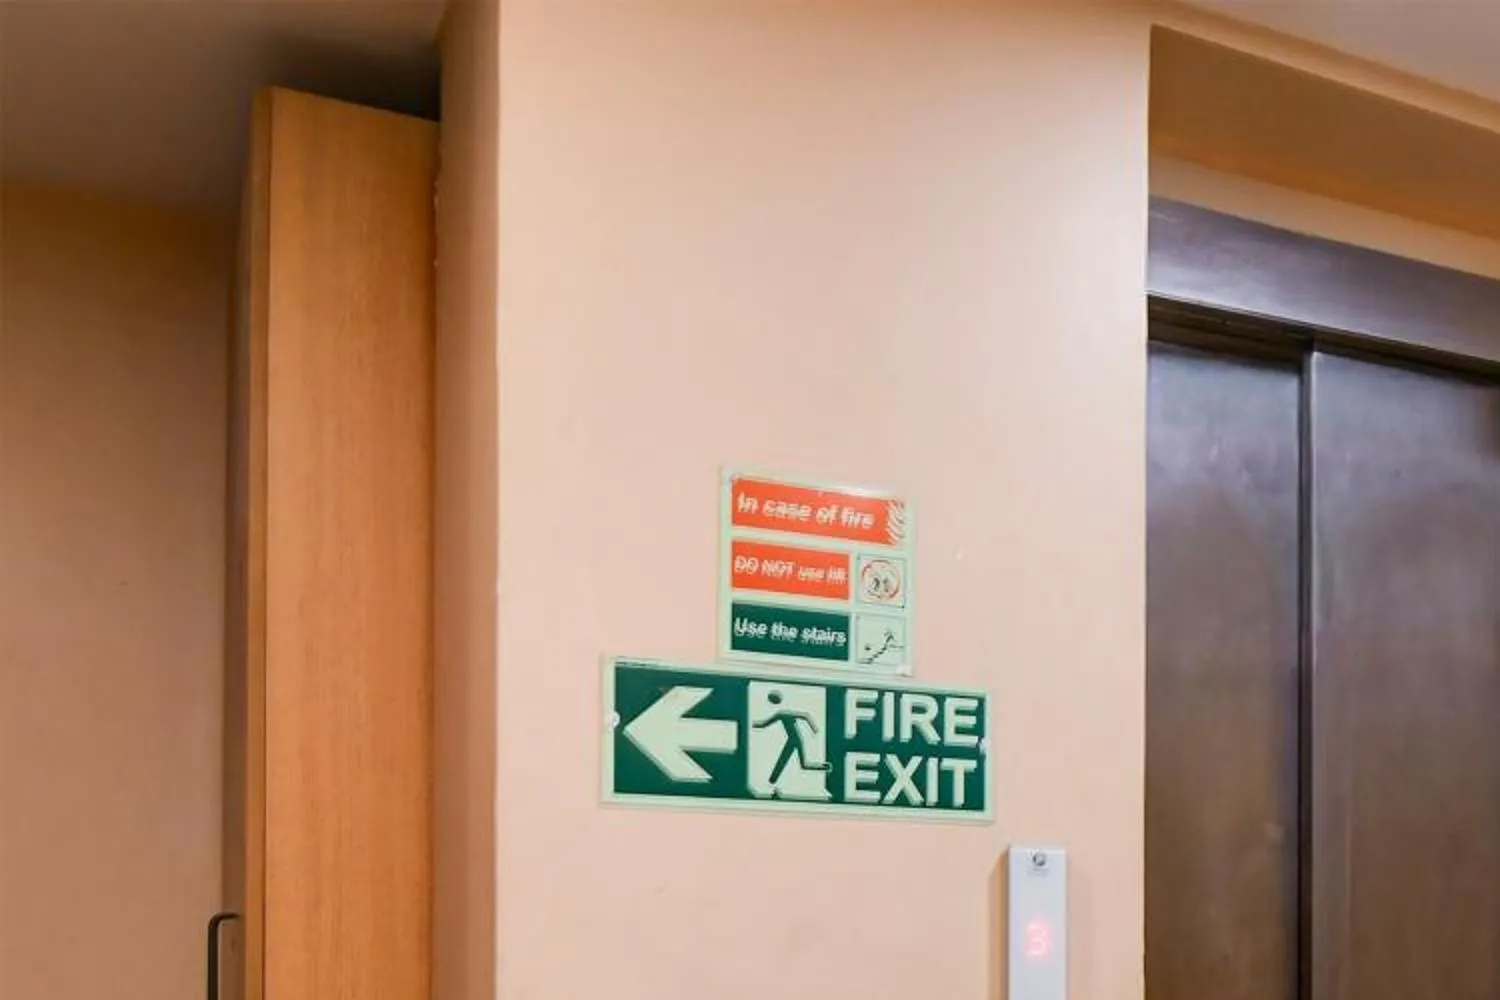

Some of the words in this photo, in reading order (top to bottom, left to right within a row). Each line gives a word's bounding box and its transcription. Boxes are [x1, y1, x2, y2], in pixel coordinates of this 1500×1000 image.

[737, 491, 758, 513] In
[762, 499, 812, 522] case
[816, 503, 838, 526] of
[841, 506, 874, 529] fire
[761, 559, 796, 580] NOT
[734, 617, 768, 638] Use
[771, 620, 799, 642] the
[801, 625, 847, 646] stairs
[843, 688, 980, 747] FIRE
[844, 750, 977, 807] EXIT
